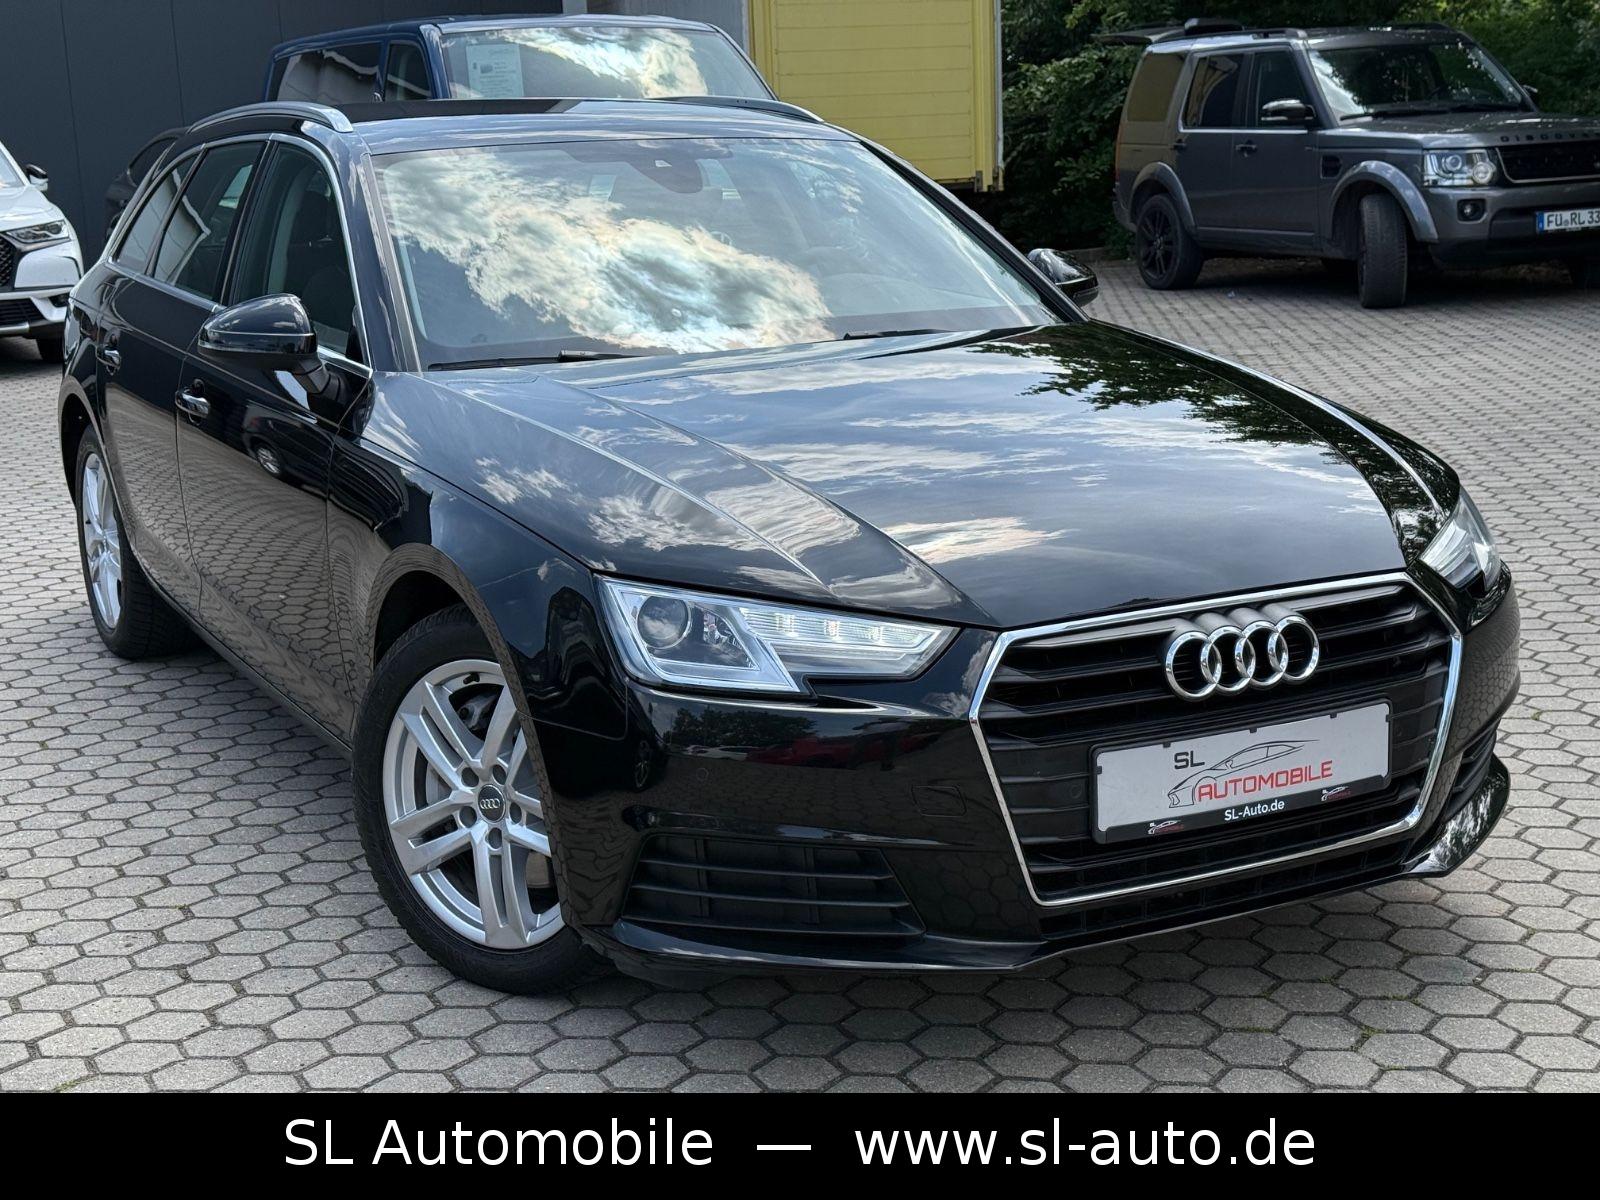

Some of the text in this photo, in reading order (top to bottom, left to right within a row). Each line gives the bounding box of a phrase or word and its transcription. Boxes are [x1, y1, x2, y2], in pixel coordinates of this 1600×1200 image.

[1571, 212, 1586, 226] RL
[1174, 750, 1205, 770] SL
[1197, 760, 1333, 801] AUTOMOBILE
[1224, 799, 1286, 821] SL-Auto.de
